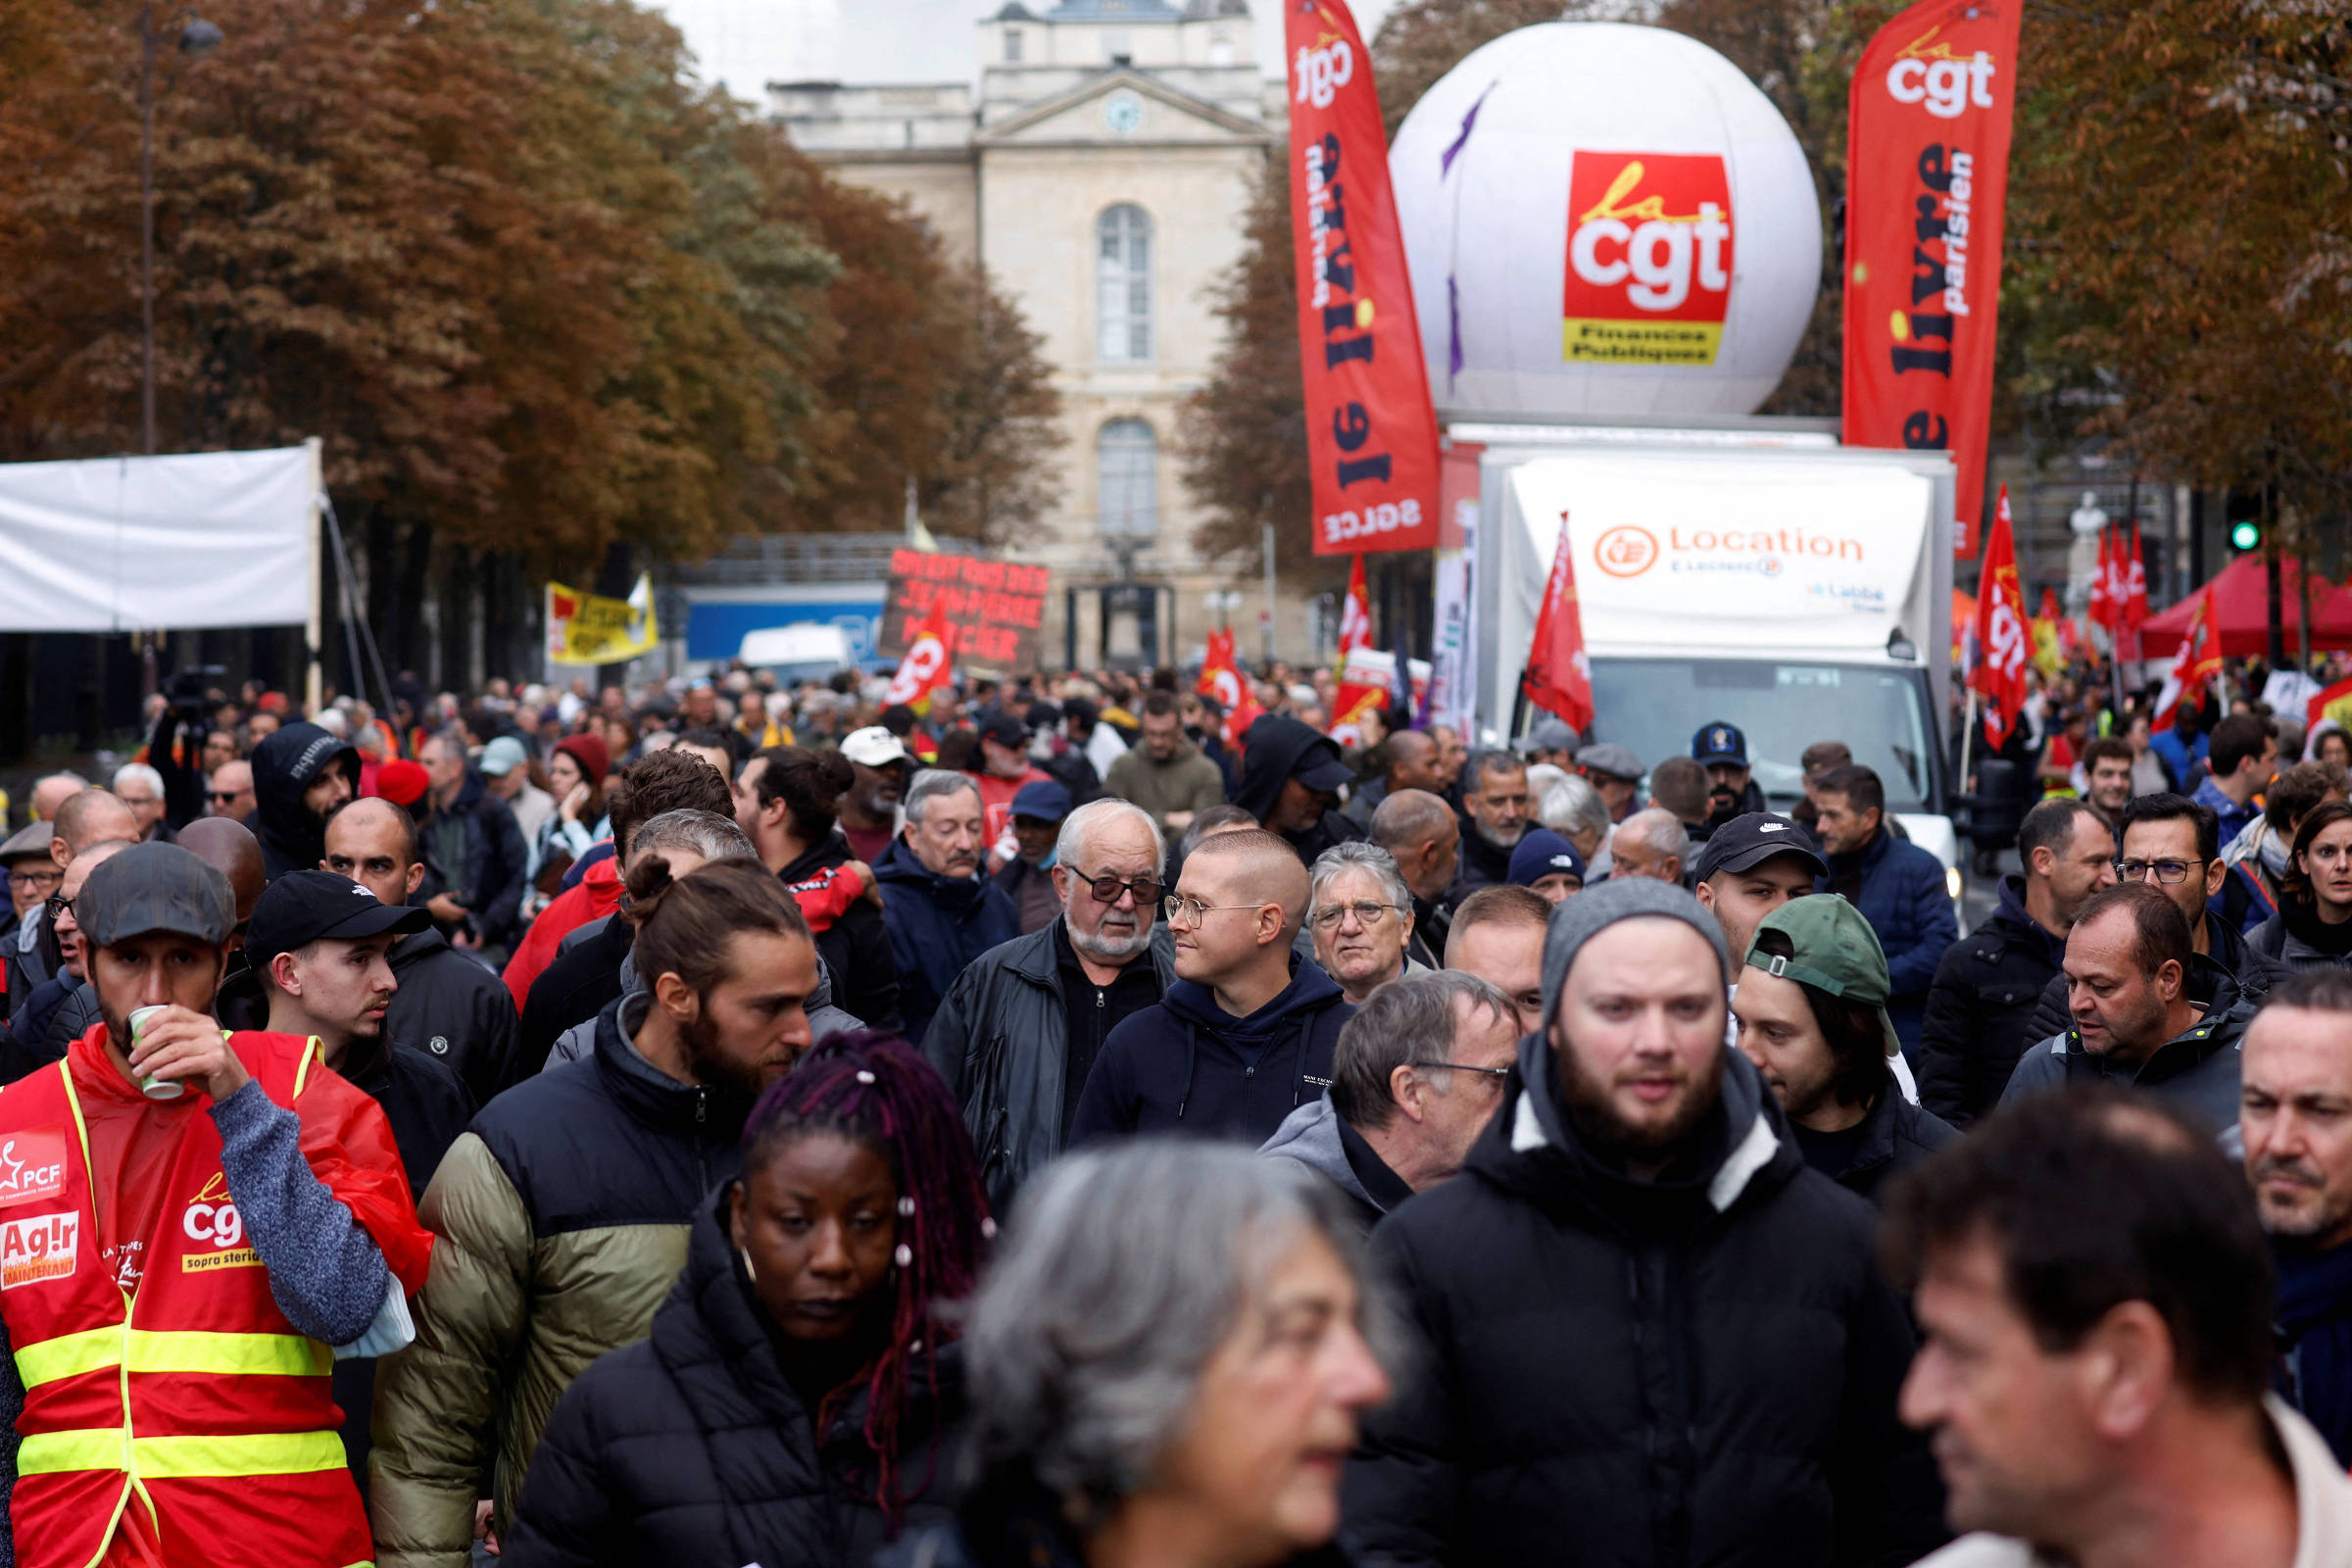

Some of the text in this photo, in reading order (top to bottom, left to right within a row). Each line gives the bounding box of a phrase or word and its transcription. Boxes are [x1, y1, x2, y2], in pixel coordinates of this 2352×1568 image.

[1886, 51, 1996, 119] cgt
[1939, 151, 1974, 317] parisien
[1570, 202, 1730, 311] cgt
[1580, 324, 1707, 342] Finances
[1571, 343, 1708, 361] Publiques
[1670, 526, 1864, 562] Location
[23, 1164, 61, 1189] PCF
[182, 1203, 242, 1248] cg
[3, 1260, 74, 1287] MAINTENANT
[187, 1250, 260, 1269] sopra steria
